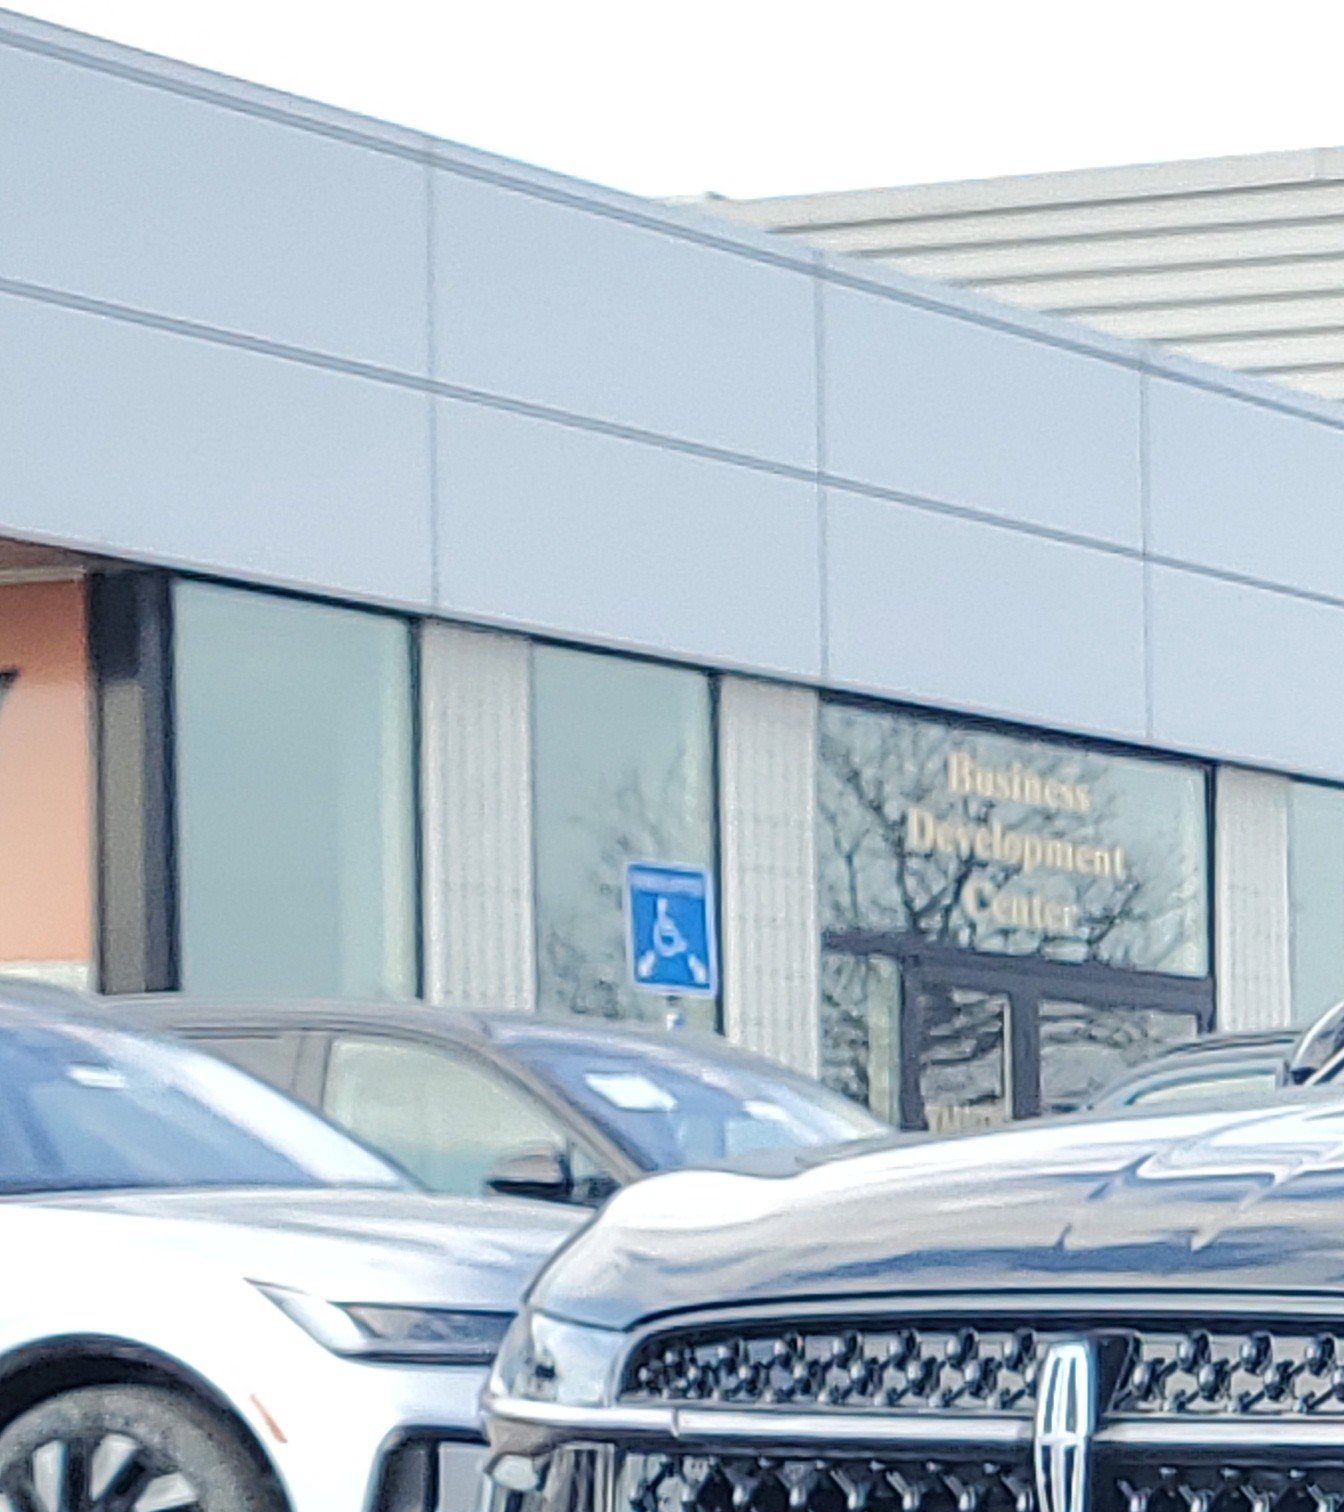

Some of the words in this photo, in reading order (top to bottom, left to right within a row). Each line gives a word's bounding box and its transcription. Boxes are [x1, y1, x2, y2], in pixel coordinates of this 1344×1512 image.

[948, 753, 1090, 813] Business
[907, 807, 1125, 880] Development
[962, 875, 1077, 931] Center
